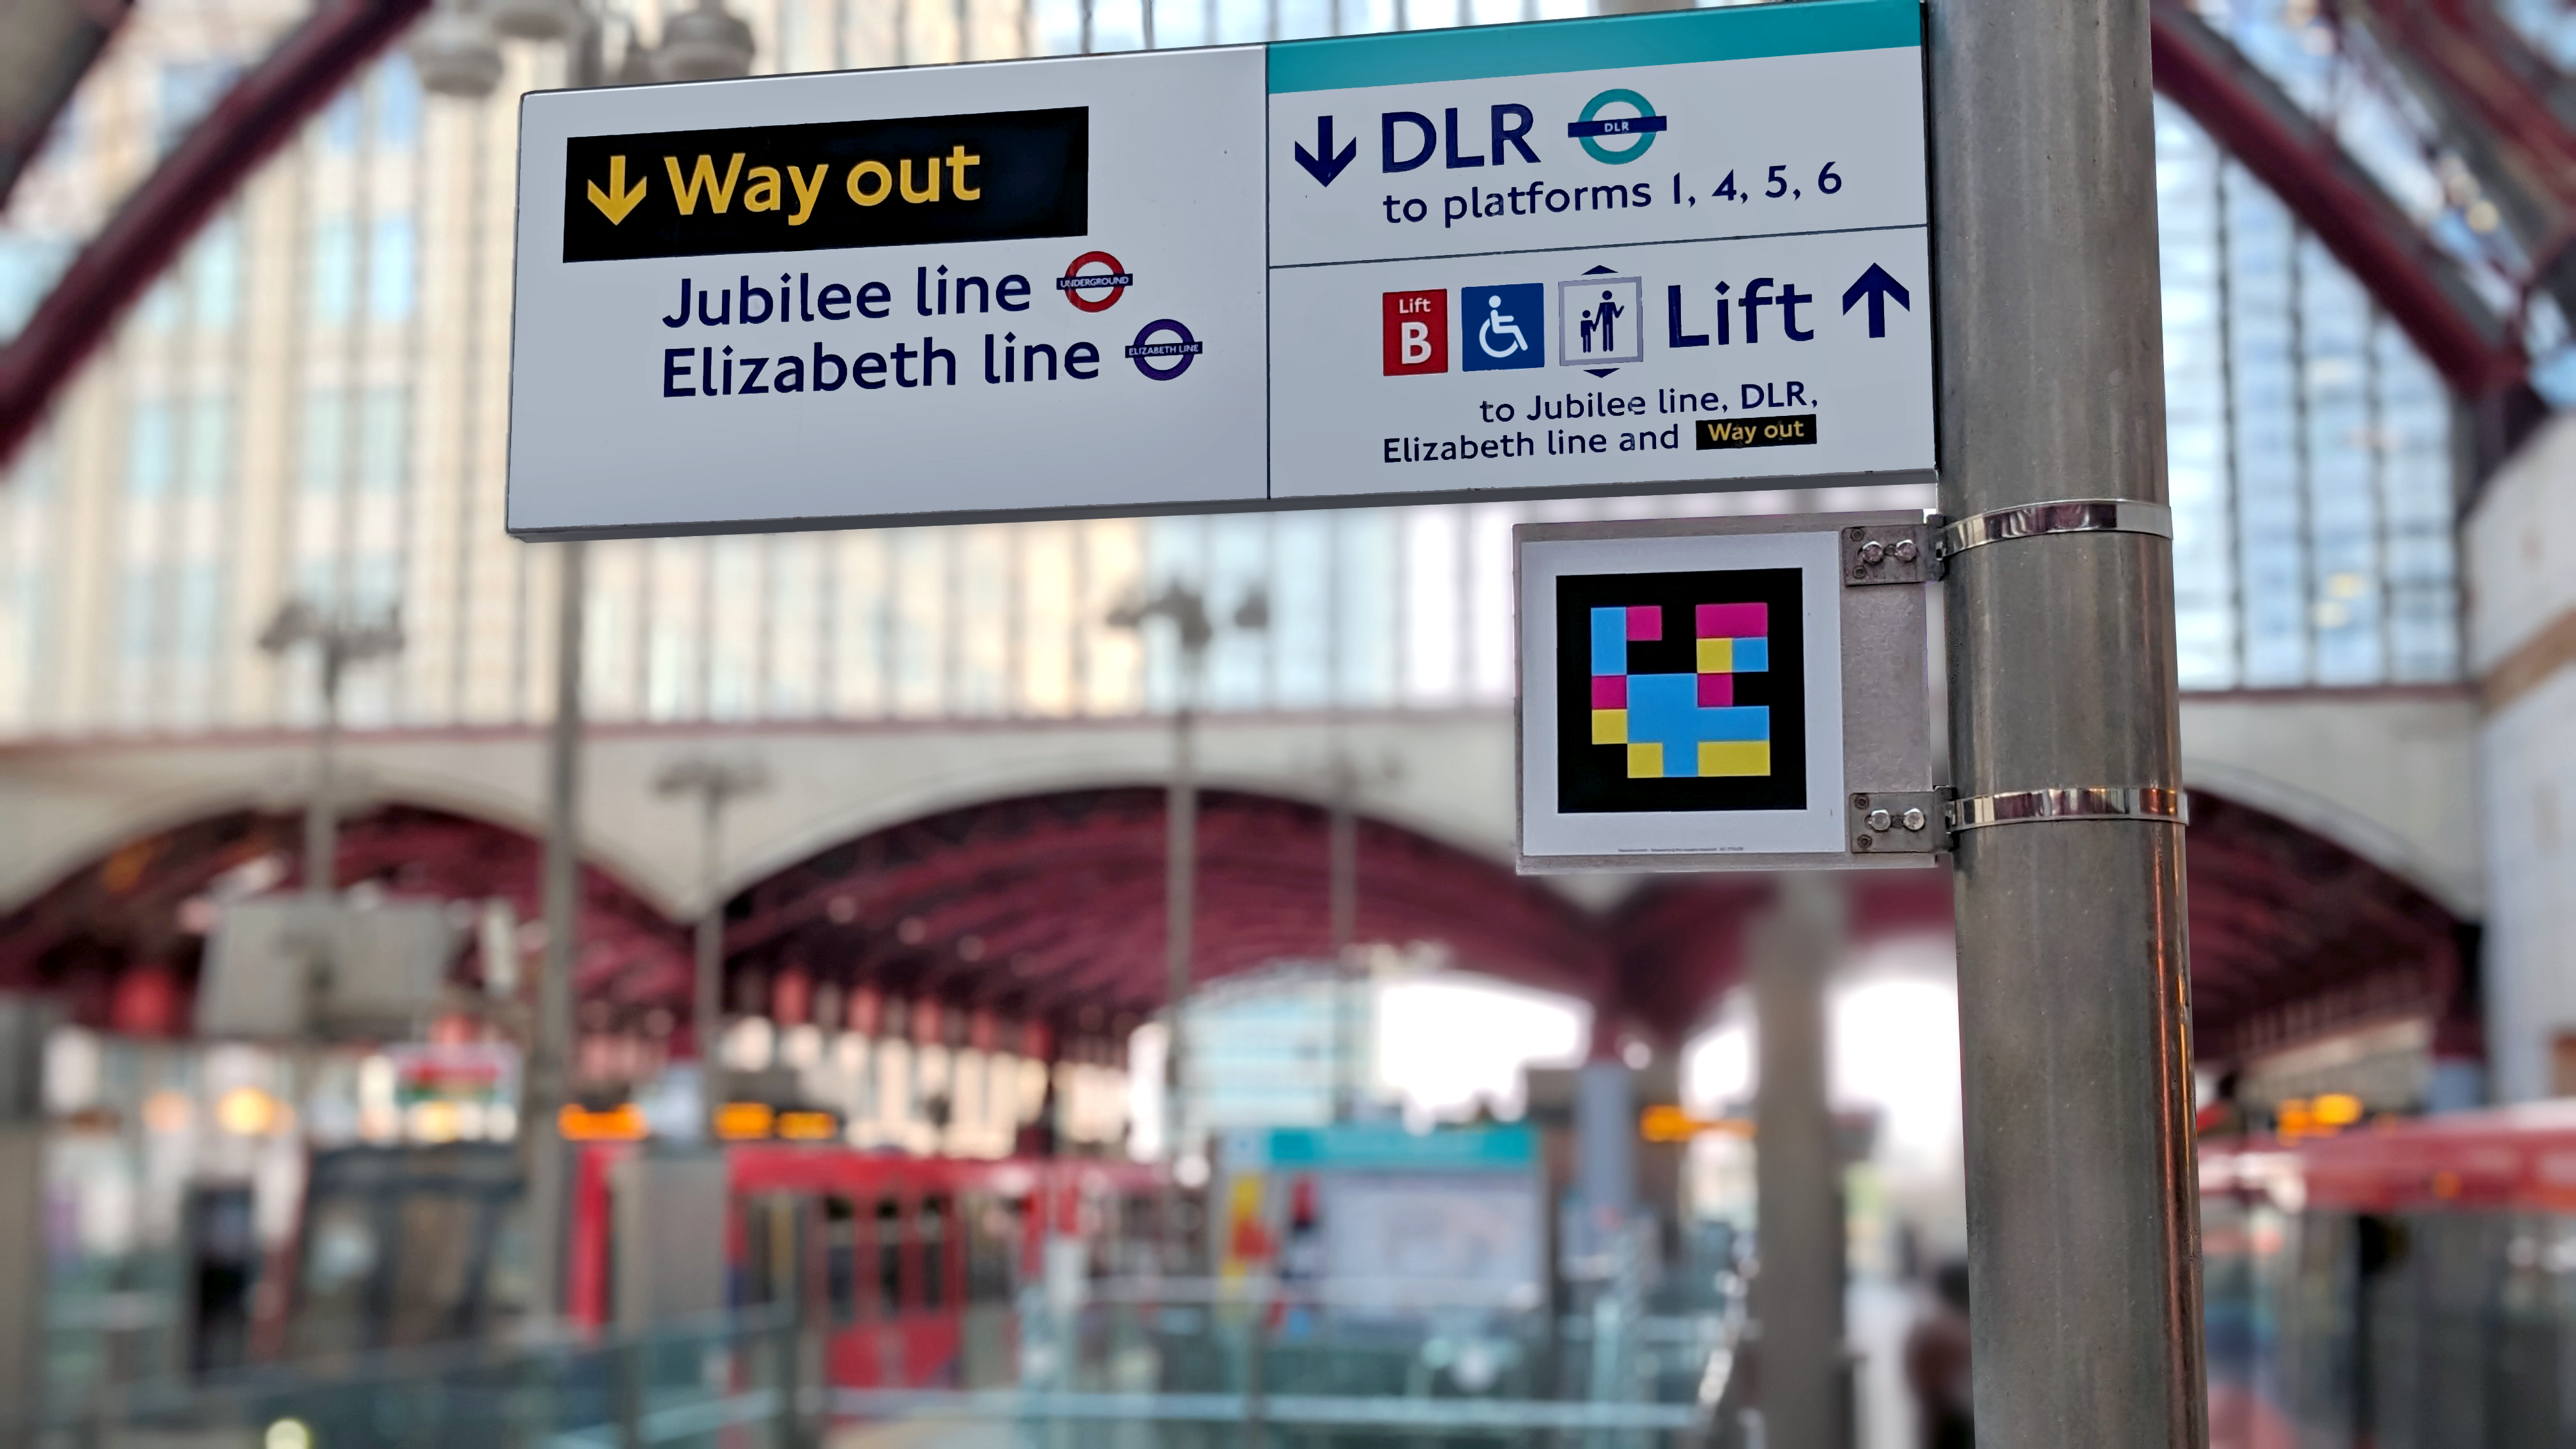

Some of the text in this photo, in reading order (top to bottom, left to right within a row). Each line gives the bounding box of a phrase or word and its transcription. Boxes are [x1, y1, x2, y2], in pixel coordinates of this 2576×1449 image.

[1382, 103, 1541, 173] DLR
[1605, 122, 1629, 132] DLR
[664, 146, 980, 226] Way out
[1383, 162, 1841, 228] to platforms 1, 4, 5, 6
[663, 264, 1031, 328] Jubilee line
[1061, 276, 1129, 288] UNDERGROUND
[1400, 298, 1430, 313] Lift
[1668, 278, 1814, 348] Lift
[664, 332, 1100, 397] Elizabeth line
[1128, 344, 1199, 356] ELIZABETH LINE
[1402, 322, 1431, 364] B
[1480, 381, 1817, 422] to Jubilee line, DLR,
[1384, 420, 1804, 463] Elizabeth line and Way out
